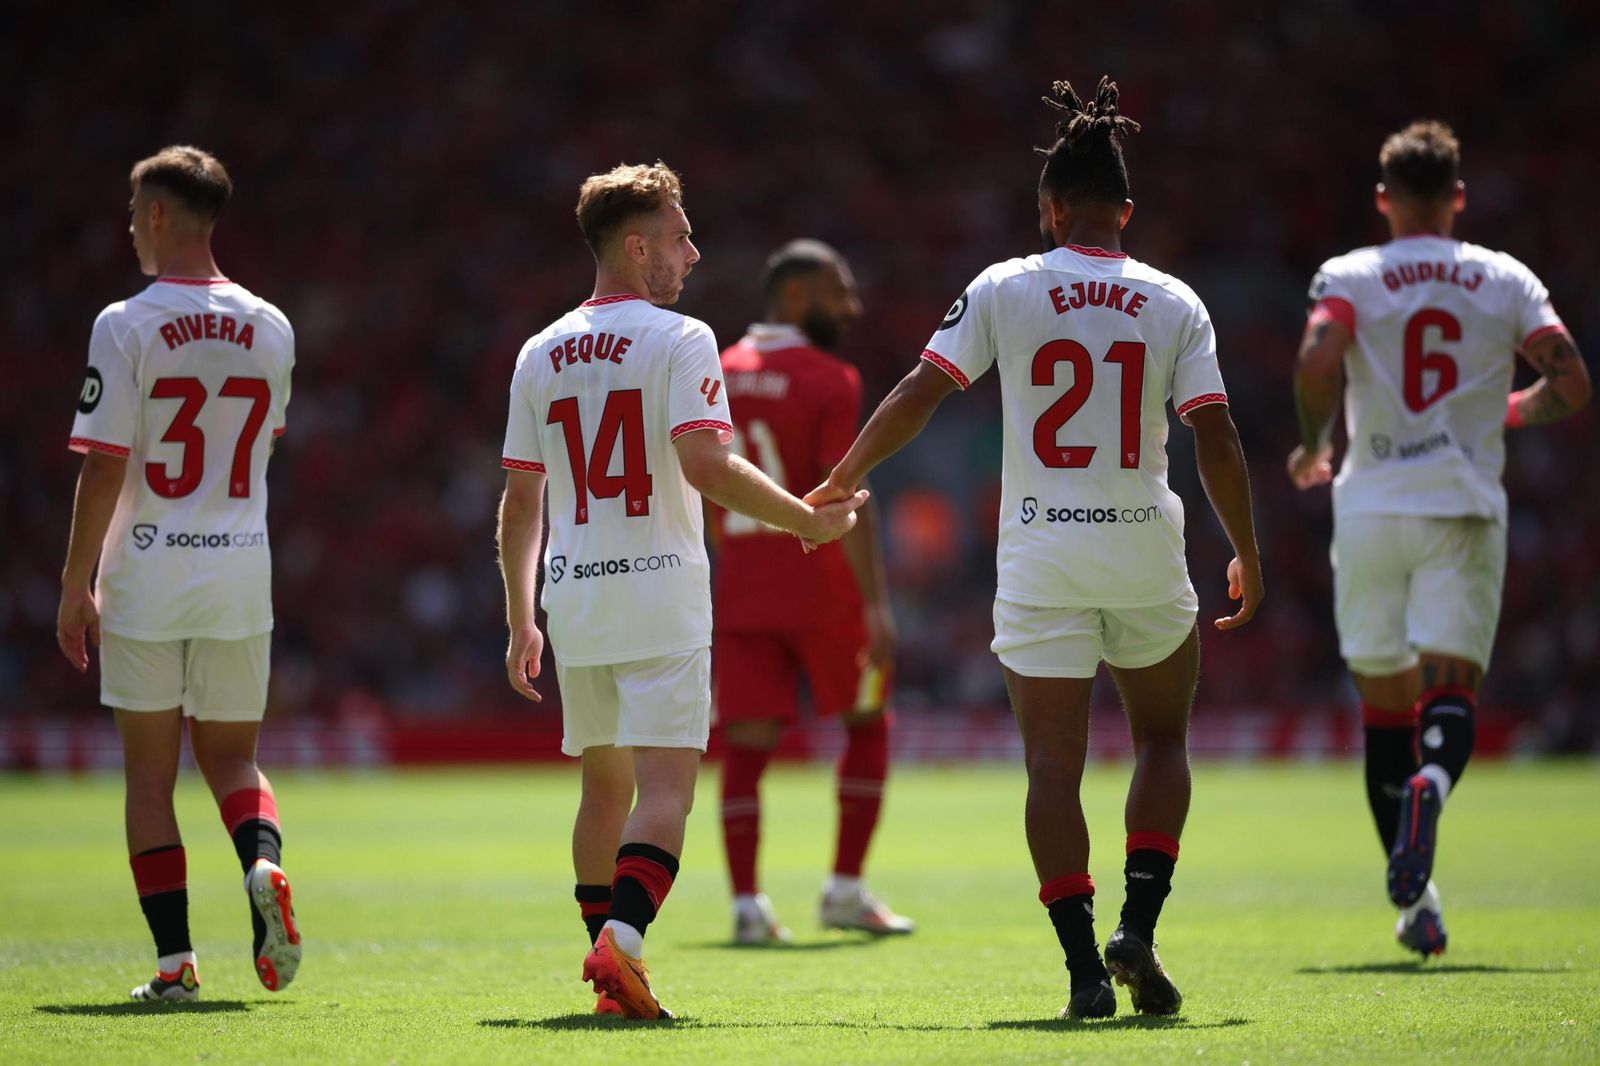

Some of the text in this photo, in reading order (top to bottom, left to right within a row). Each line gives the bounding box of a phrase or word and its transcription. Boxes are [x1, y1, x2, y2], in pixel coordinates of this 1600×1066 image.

[160, 312, 255, 350] RIVERA
[549, 332, 633, 374] PEQUE
[1048, 281, 1149, 319] EJUKE
[1031, 338, 1147, 470] 21
[1403, 307, 1462, 415] 6
[145, 376, 272, 499] 37
[546, 388, 653, 526] 14
